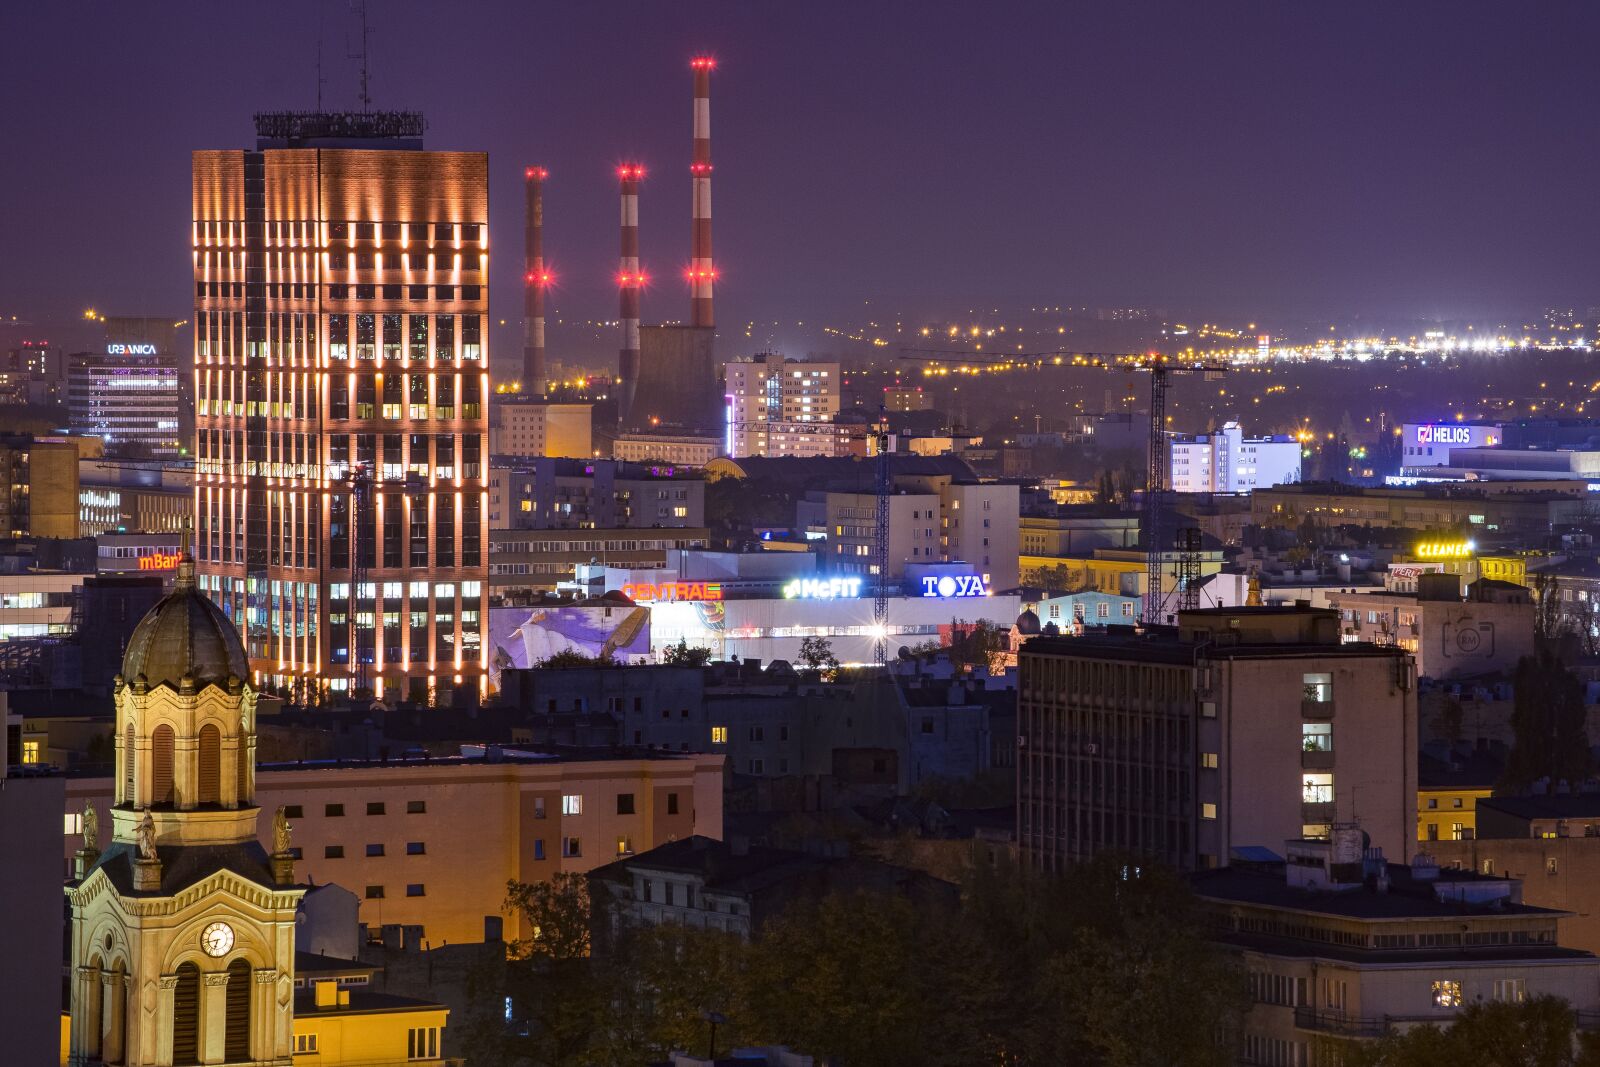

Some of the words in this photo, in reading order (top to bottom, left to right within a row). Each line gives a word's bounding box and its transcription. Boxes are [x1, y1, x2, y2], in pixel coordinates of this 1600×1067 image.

[108, 344, 156, 354] URBANICA
[1433, 427, 1470, 443] HELIOS
[1418, 544, 1470, 556] CLEANER
[922, 576, 986, 597] TOYA
